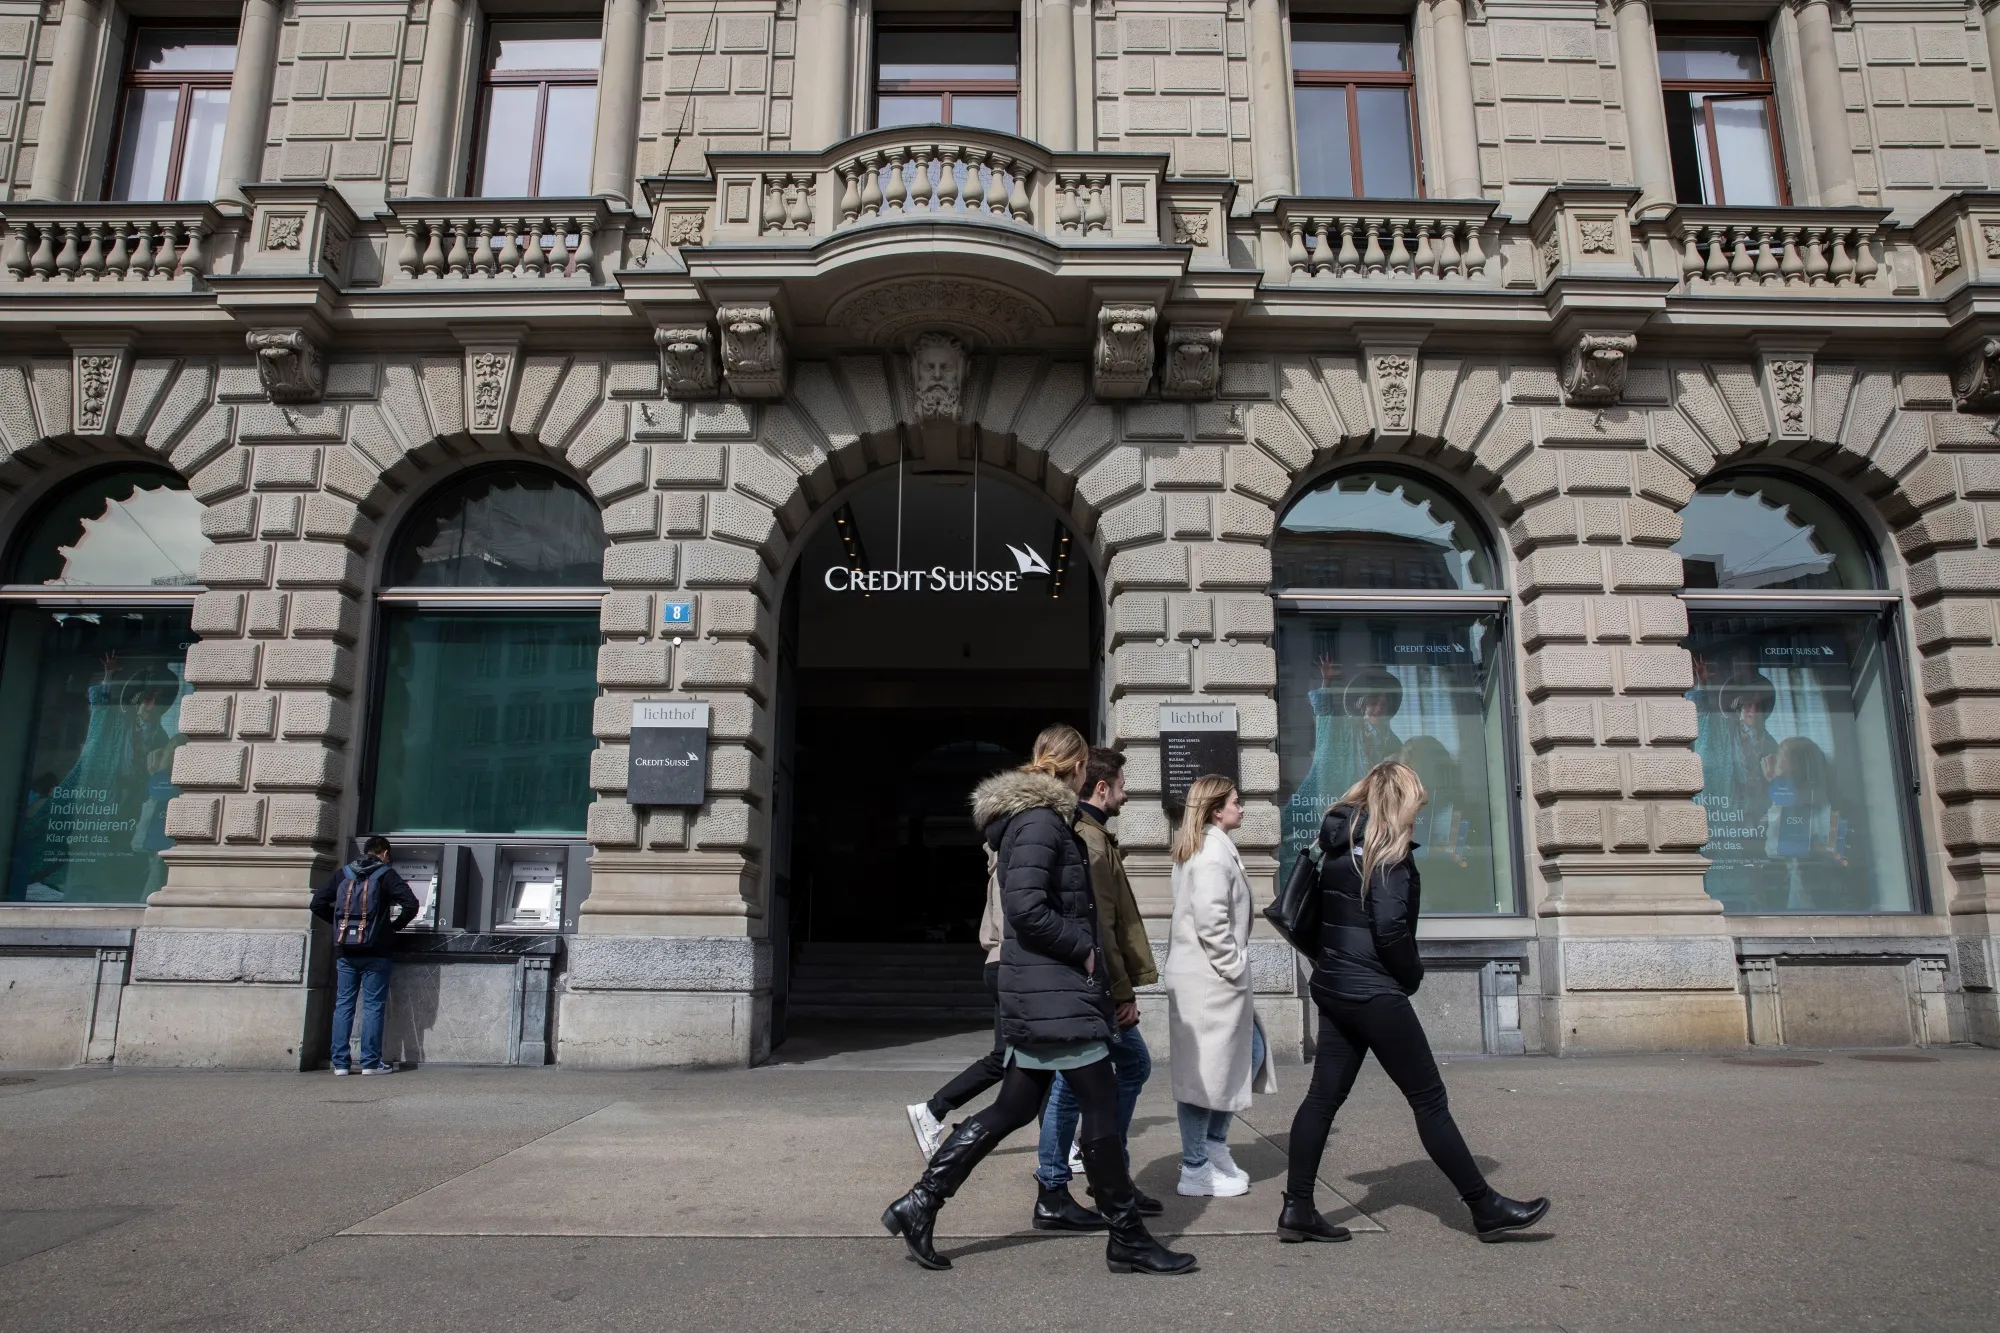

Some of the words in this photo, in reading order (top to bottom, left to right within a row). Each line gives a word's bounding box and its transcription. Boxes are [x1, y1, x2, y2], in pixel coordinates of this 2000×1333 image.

[824, 566, 926, 592] CREDIT
[930, 566, 1019, 592] SUISSE
[673, 605, 682, 620] 8
[1394, 645, 1424, 653] CREDIT
[1426, 645, 1452, 653] SUISSE
[1765, 647, 1794, 655] CREDIT
[1795, 647, 1821, 655] SUISSE
[643, 707, 697, 720] lichthof
[1170, 711, 1224, 724] lichthof
[635, 757, 665, 767] CREDIT
[665, 757, 690, 767] SUISSE
[53, 786, 107, 802] Banking
[1291, 793, 1341, 806] Bankin
[1693, 793, 1729, 809] nking
[50, 803, 119, 815] individuell
[1707, 809, 1744, 822] iduell
[48, 818, 136, 831] kombinieren?
[46, 833, 65, 843] Klar
[66, 834, 89, 845] geht
[91, 834, 111, 843] das.
[1723, 841, 1744, 850] das.
